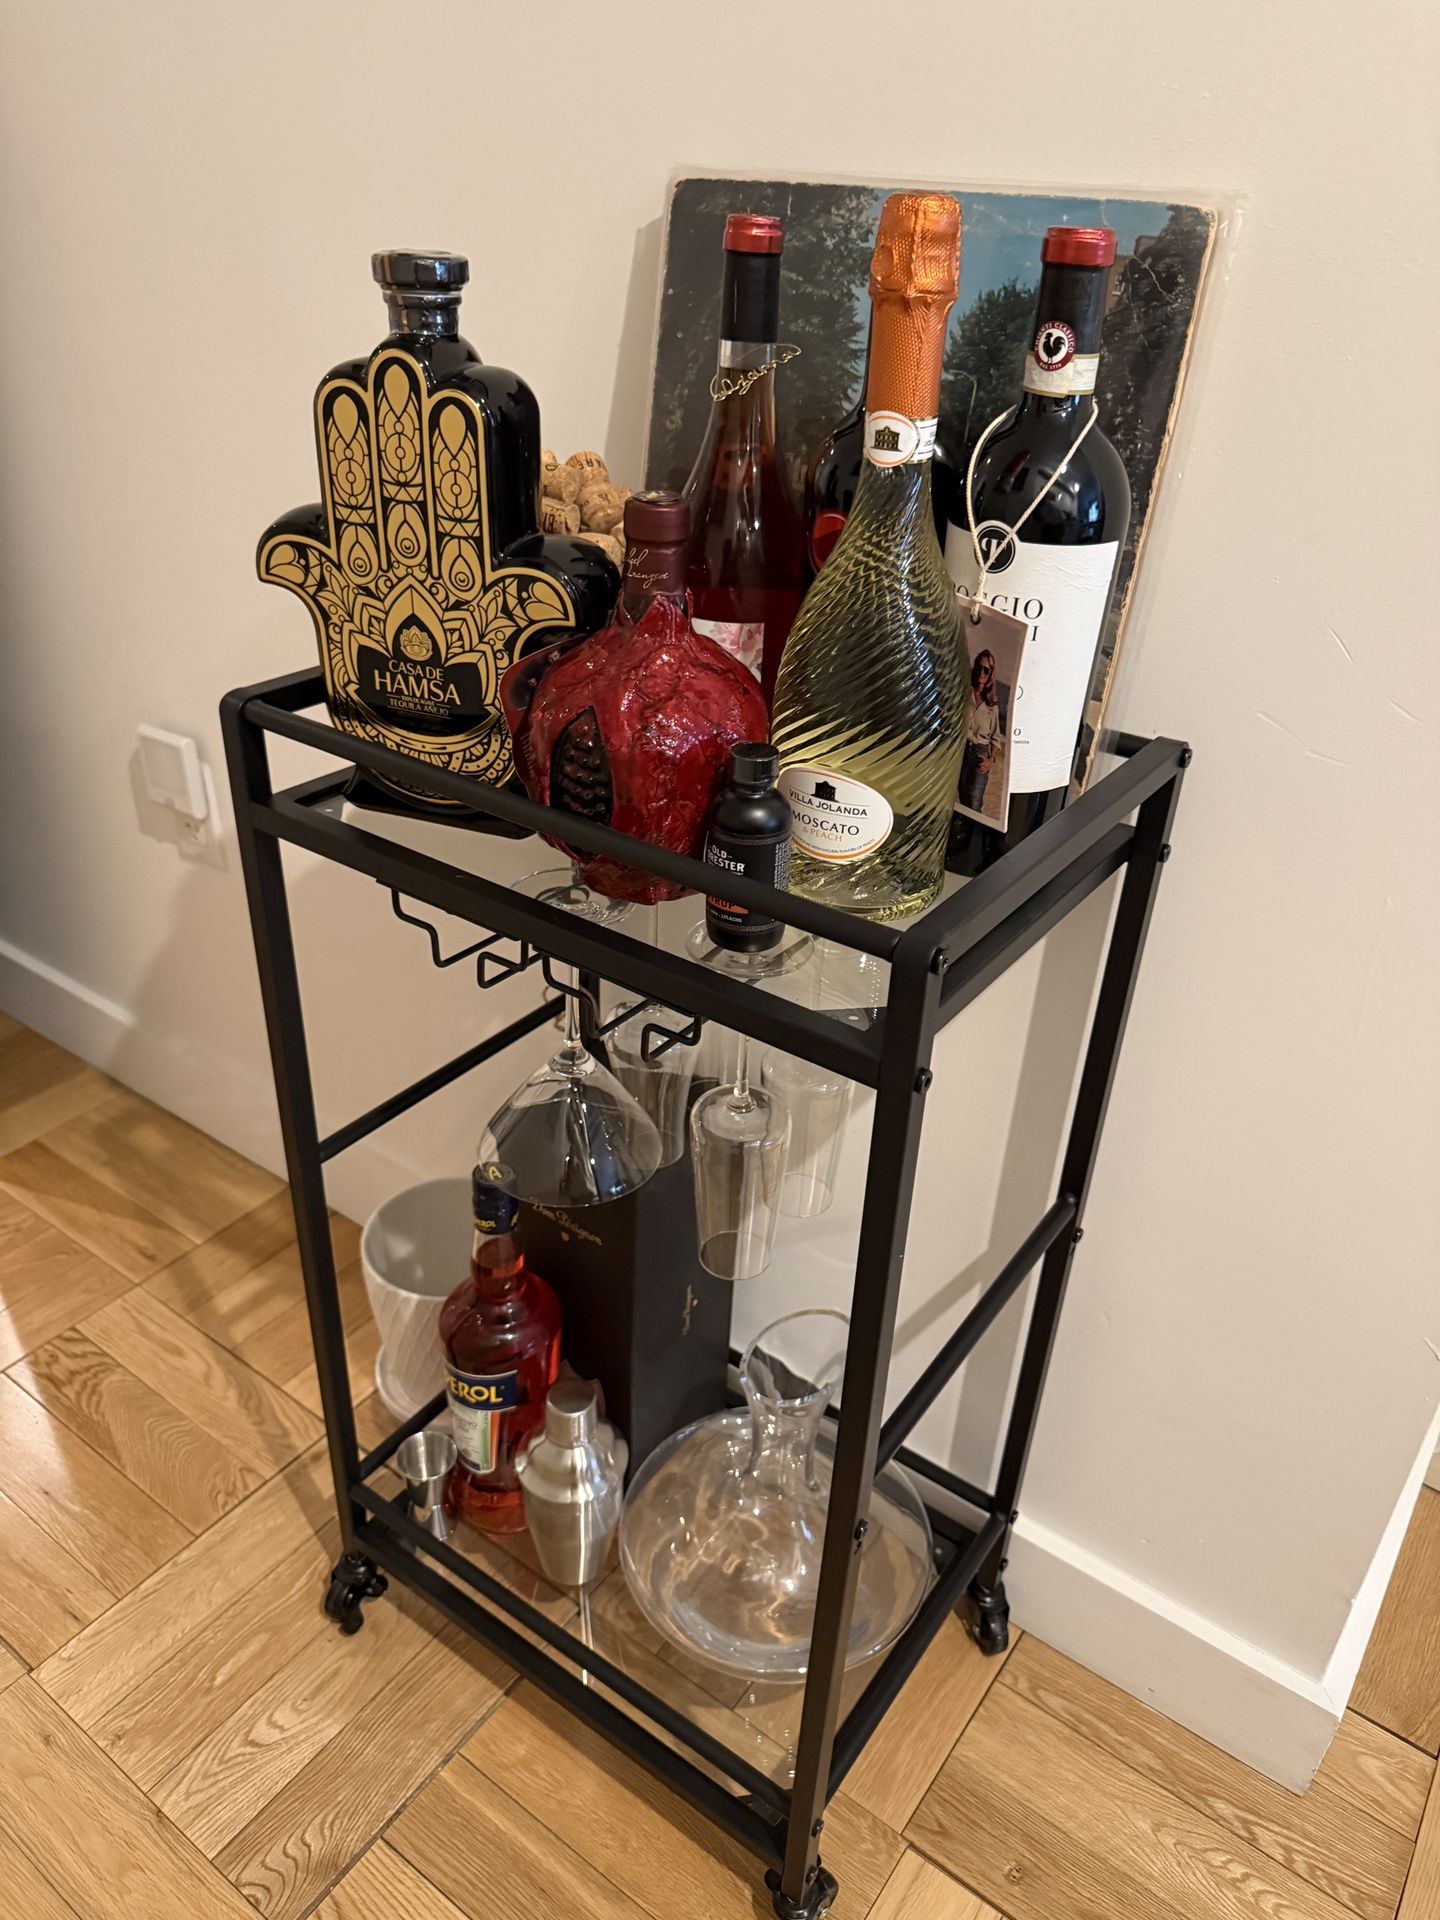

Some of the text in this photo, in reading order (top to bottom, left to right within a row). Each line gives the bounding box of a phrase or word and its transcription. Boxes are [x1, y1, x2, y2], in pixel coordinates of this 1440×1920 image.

[1054, 322, 1075, 353] CLASSICO
[388, 660, 445, 682] CASA DE
[374, 669, 462, 706] HAMSA
[390, 698, 422, 712] TEQUILA
[789, 789, 868, 817] VILLA JOLANDA
[792, 808, 860, 836] MOSCATO
[810, 827, 843, 842] PEACH
[711, 844, 728, 859] OLD
[488, 1166, 502, 1181] A
